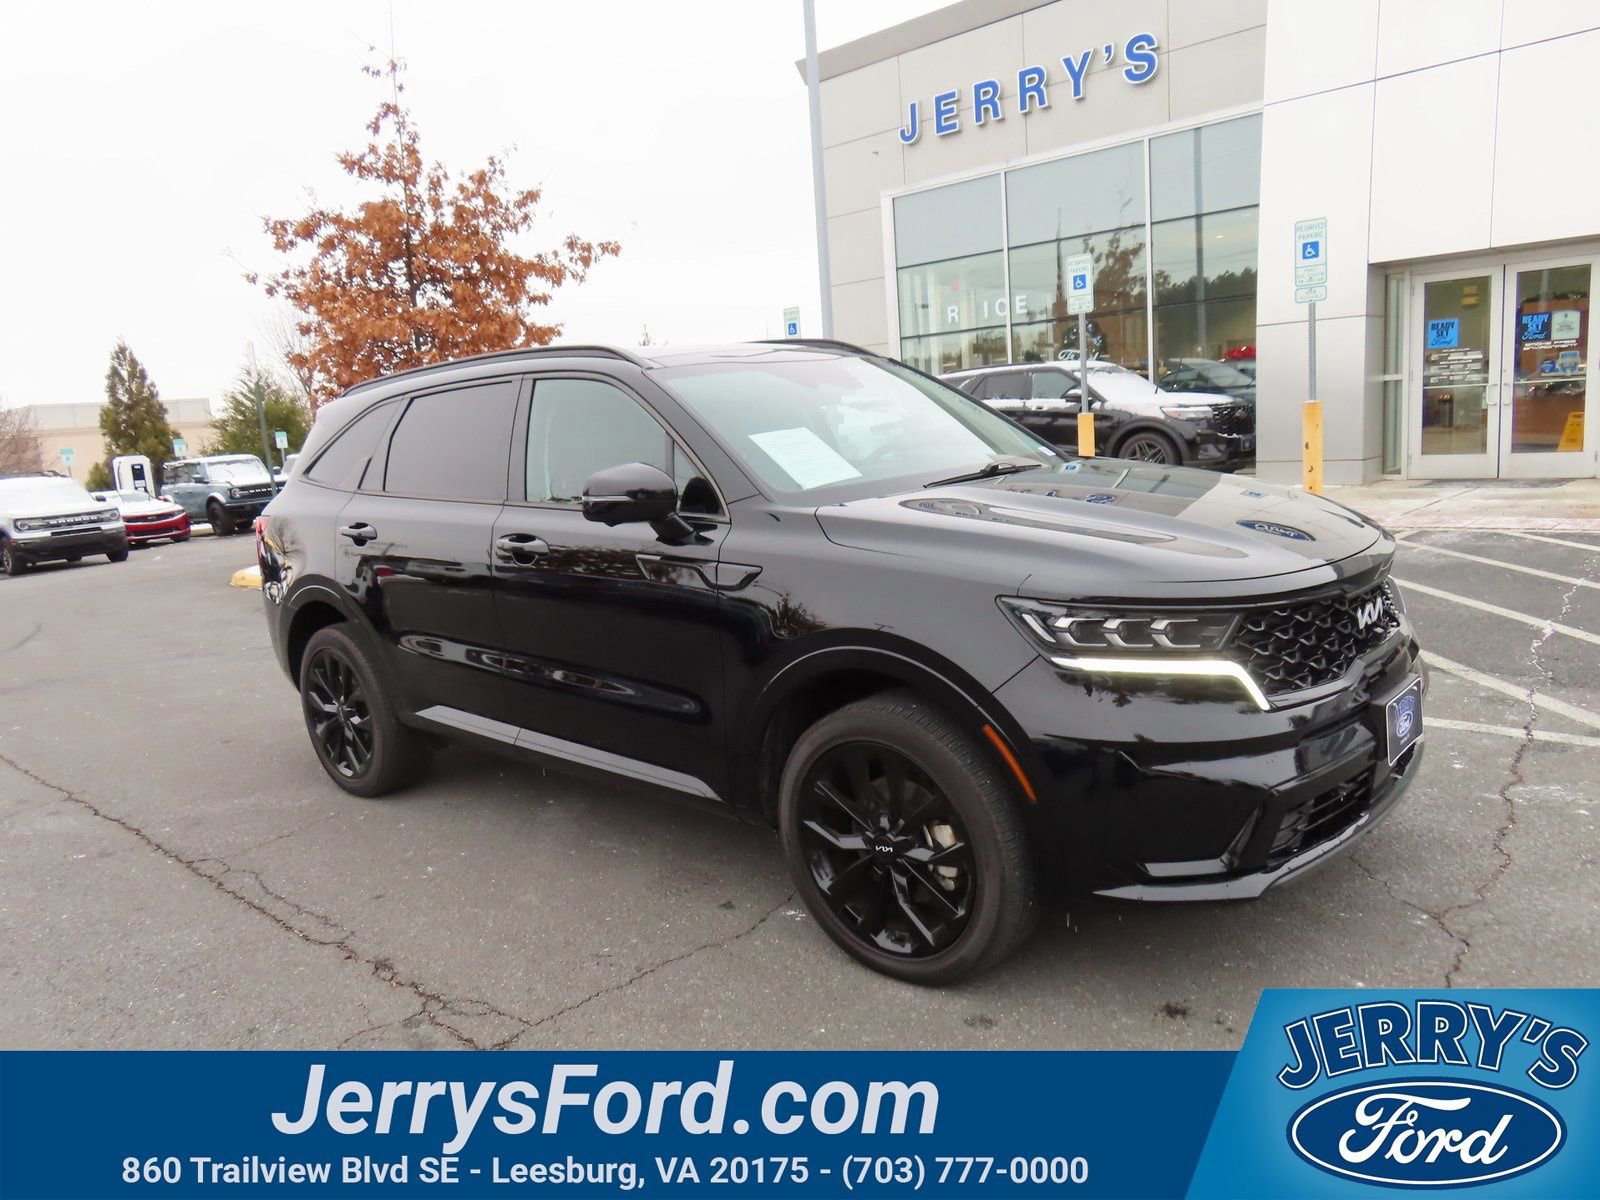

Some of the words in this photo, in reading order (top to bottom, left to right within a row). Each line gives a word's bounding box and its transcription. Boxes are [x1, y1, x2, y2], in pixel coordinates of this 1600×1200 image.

[898, 33, 1160, 144] JERRY'S
[1297, 231, 1324, 240] PARKING
[1522, 313, 1550, 324] READY
[1430, 321, 1456, 331] READY
[1527, 321, 1543, 332] SET
[1436, 328, 1450, 338] SET
[1522, 331, 1548, 340] Ford
[1430, 337, 1454, 347] Ford
